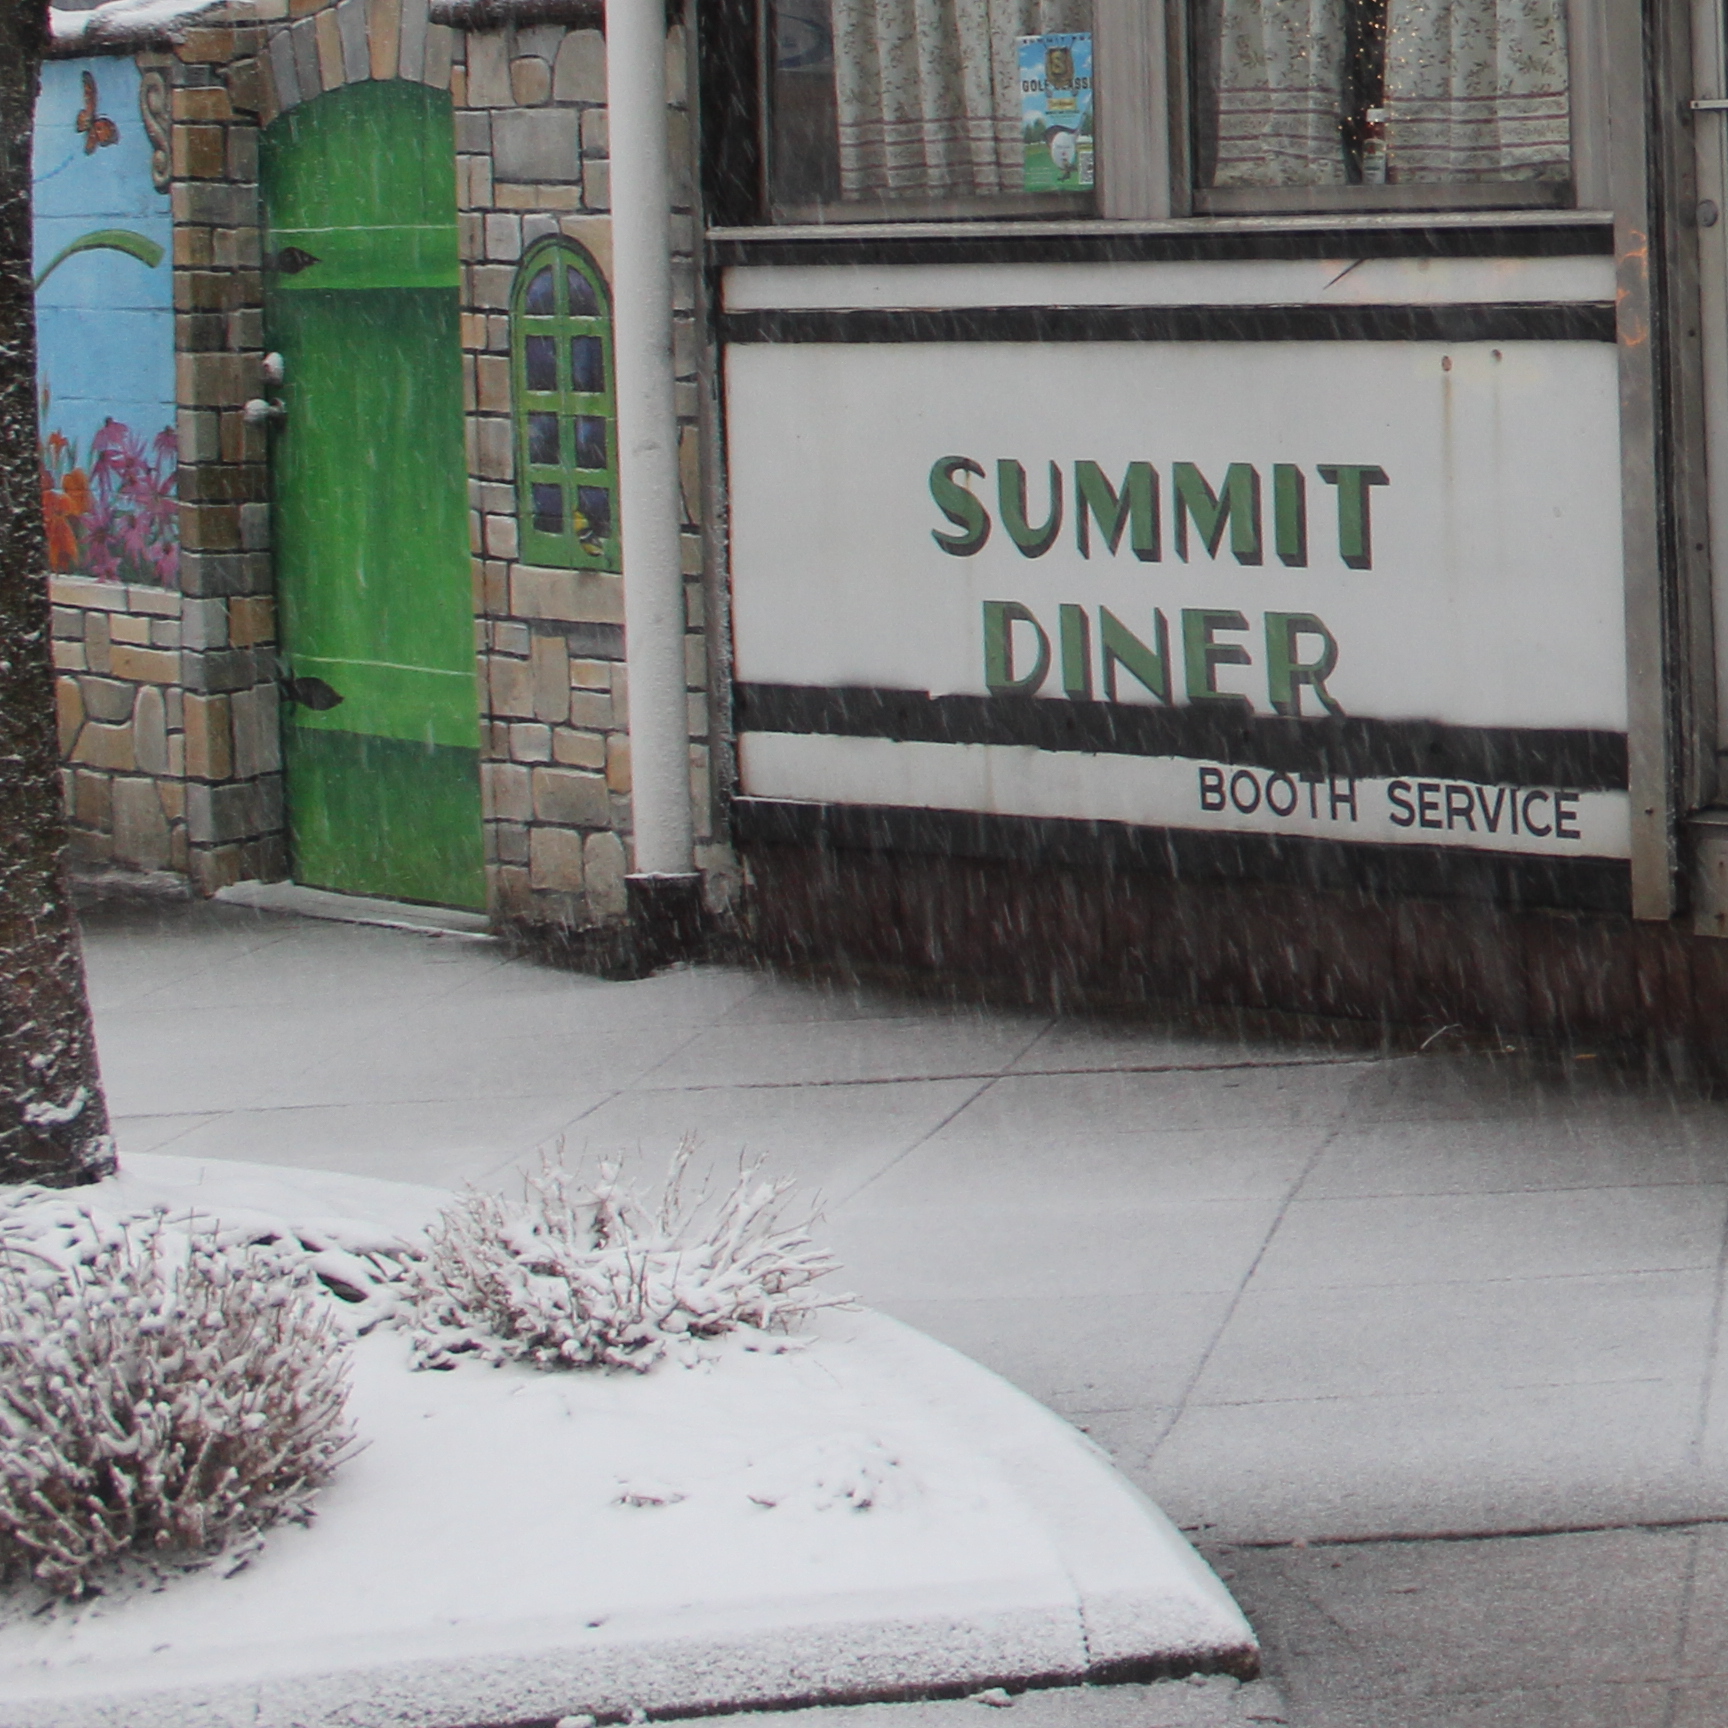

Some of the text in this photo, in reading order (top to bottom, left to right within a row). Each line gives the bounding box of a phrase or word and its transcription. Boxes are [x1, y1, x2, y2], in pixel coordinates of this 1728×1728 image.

[929, 455, 1389, 570] SUMMIT
[983, 599, 1347, 718] DINER
[1199, 766, 1581, 840] BOOTH SERVICE
